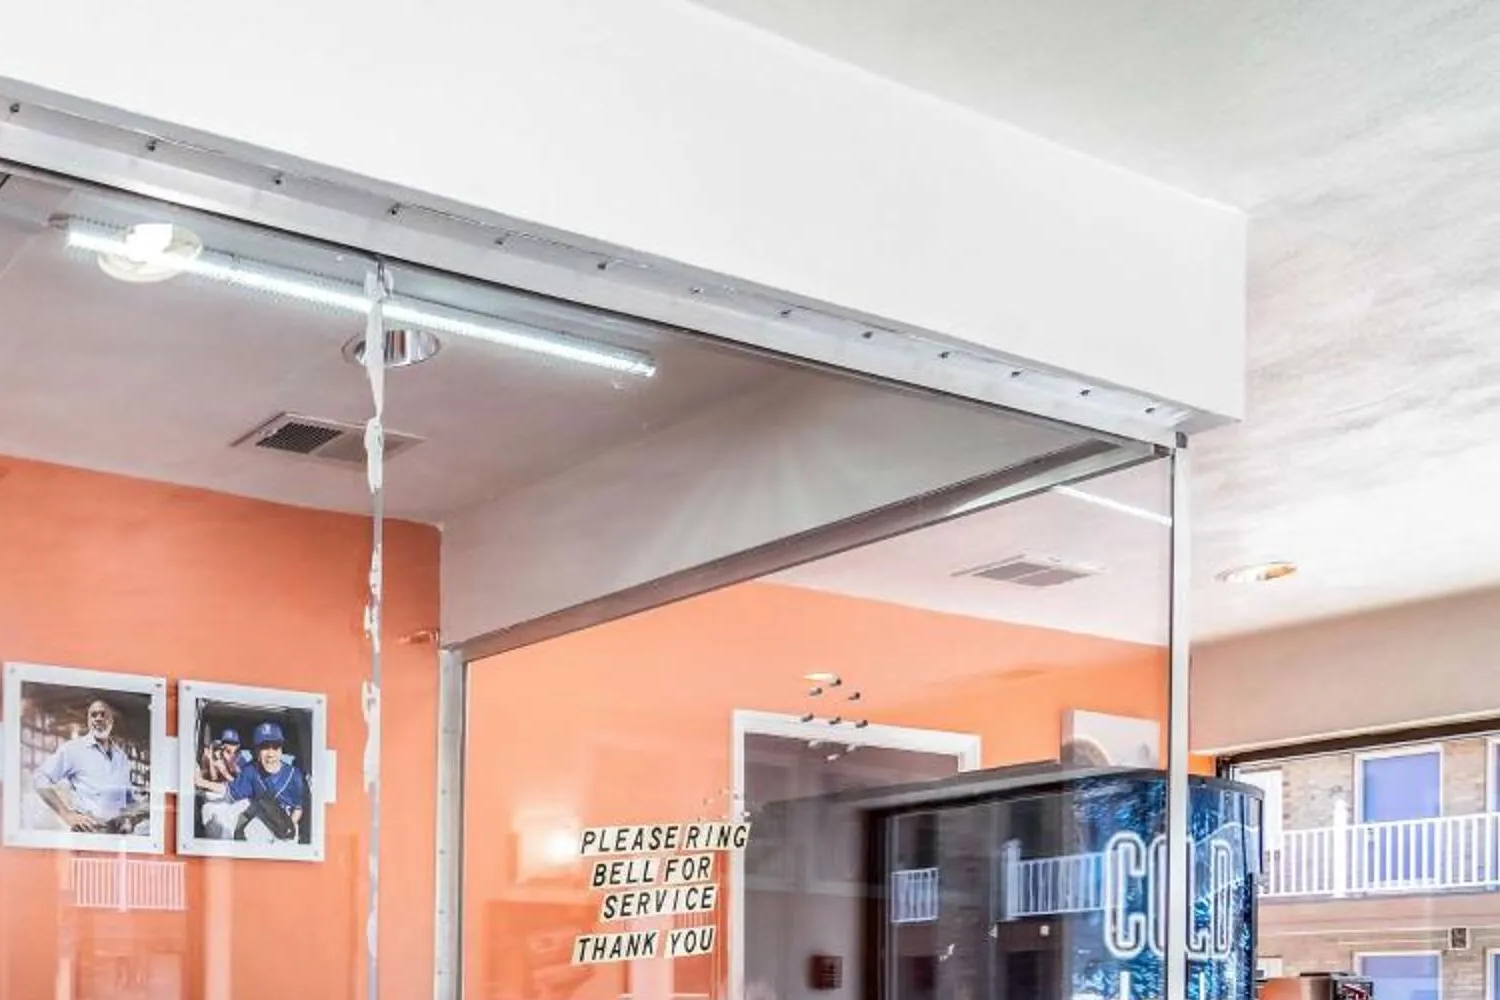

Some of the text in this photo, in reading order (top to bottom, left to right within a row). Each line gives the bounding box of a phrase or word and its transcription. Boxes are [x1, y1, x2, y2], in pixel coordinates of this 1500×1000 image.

[581, 825, 748, 854] PLEASE RING
[593, 857, 711, 886] BELL FOR
[603, 887, 715, 919] SERVICE
[578, 928, 713, 962] THANK YOU
